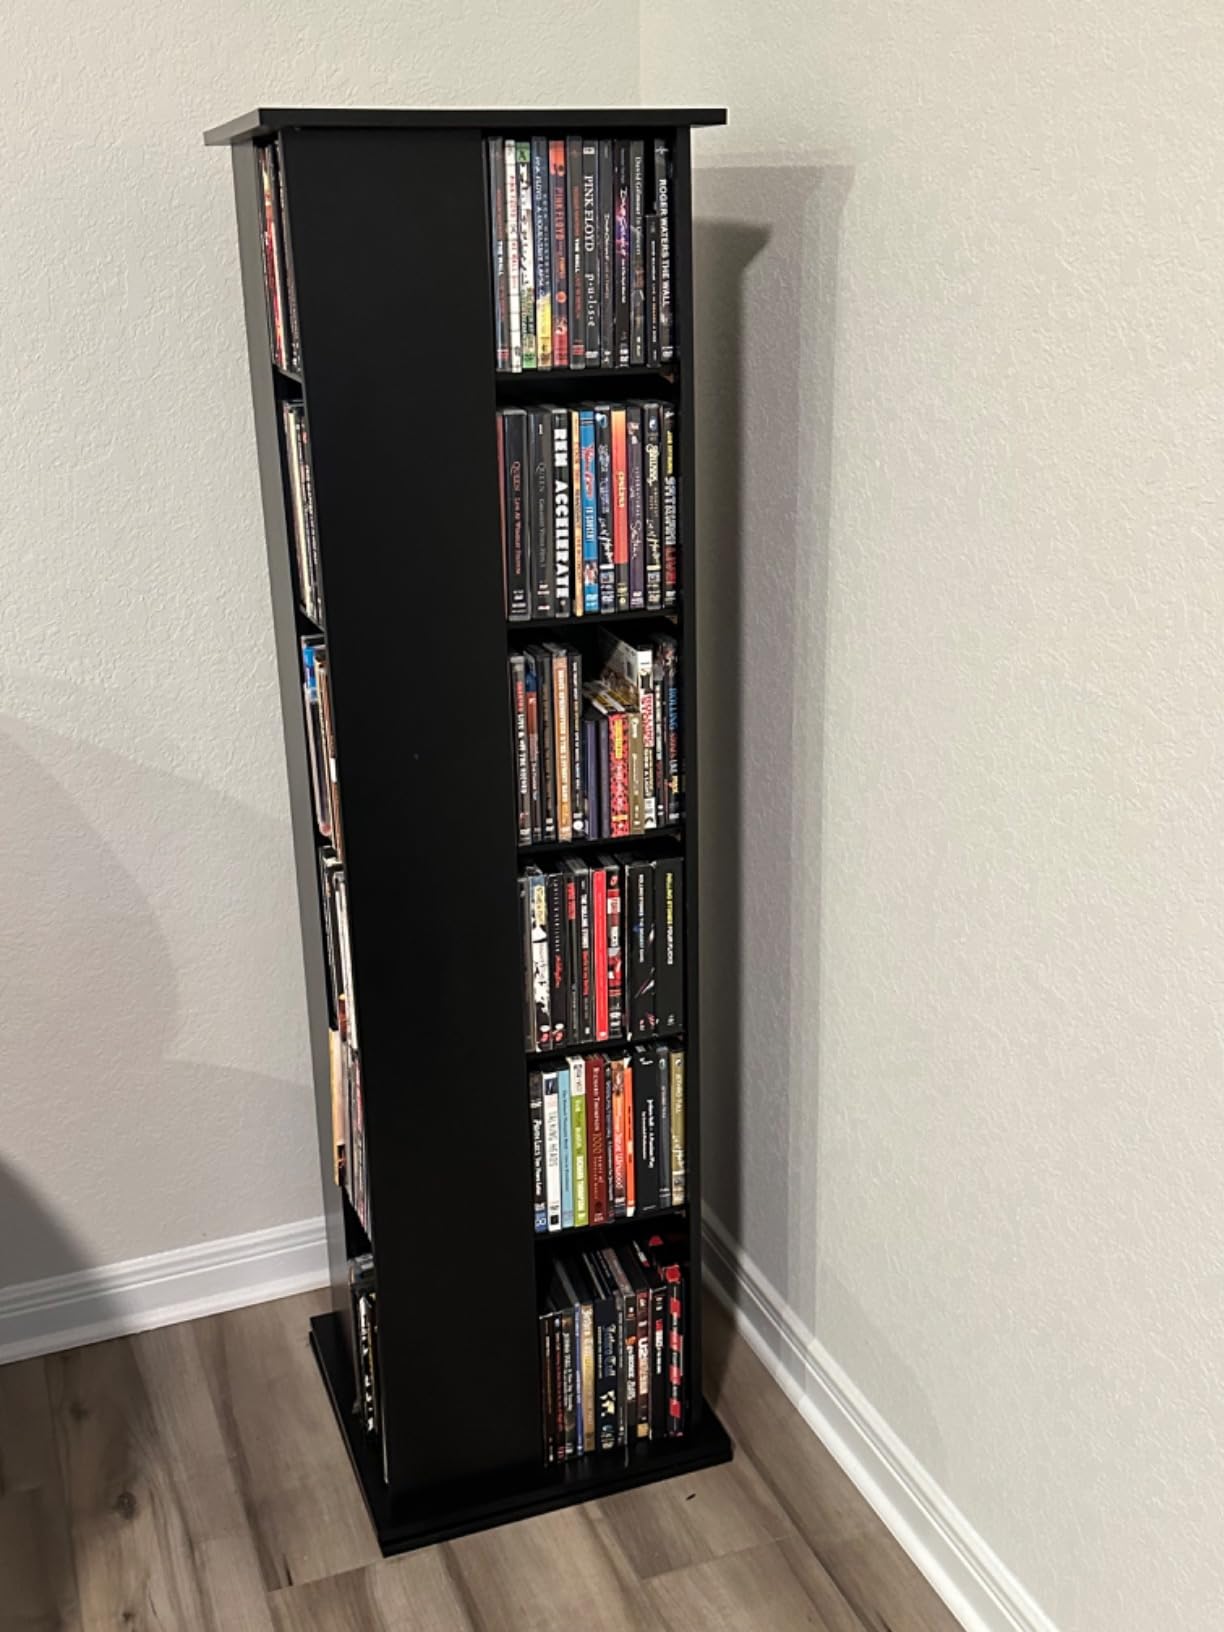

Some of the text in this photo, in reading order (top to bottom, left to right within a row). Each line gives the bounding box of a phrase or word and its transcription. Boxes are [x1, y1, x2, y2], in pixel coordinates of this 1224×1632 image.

[584, 175, 595, 252] PINK FLOYD
[658, 178, 671, 307] ROGER WATERS THE WALL
[535, 462, 547, 493] QUEEN
[554, 428, 570, 599] REM ACCELERATE
[669, 687, 678, 730] ROLLING
[592, 1067, 600, 1097] RICHARD
[675, 1073, 683, 1114] JETHRO TULL
[593, 1097, 601, 1132] THOMPSON
